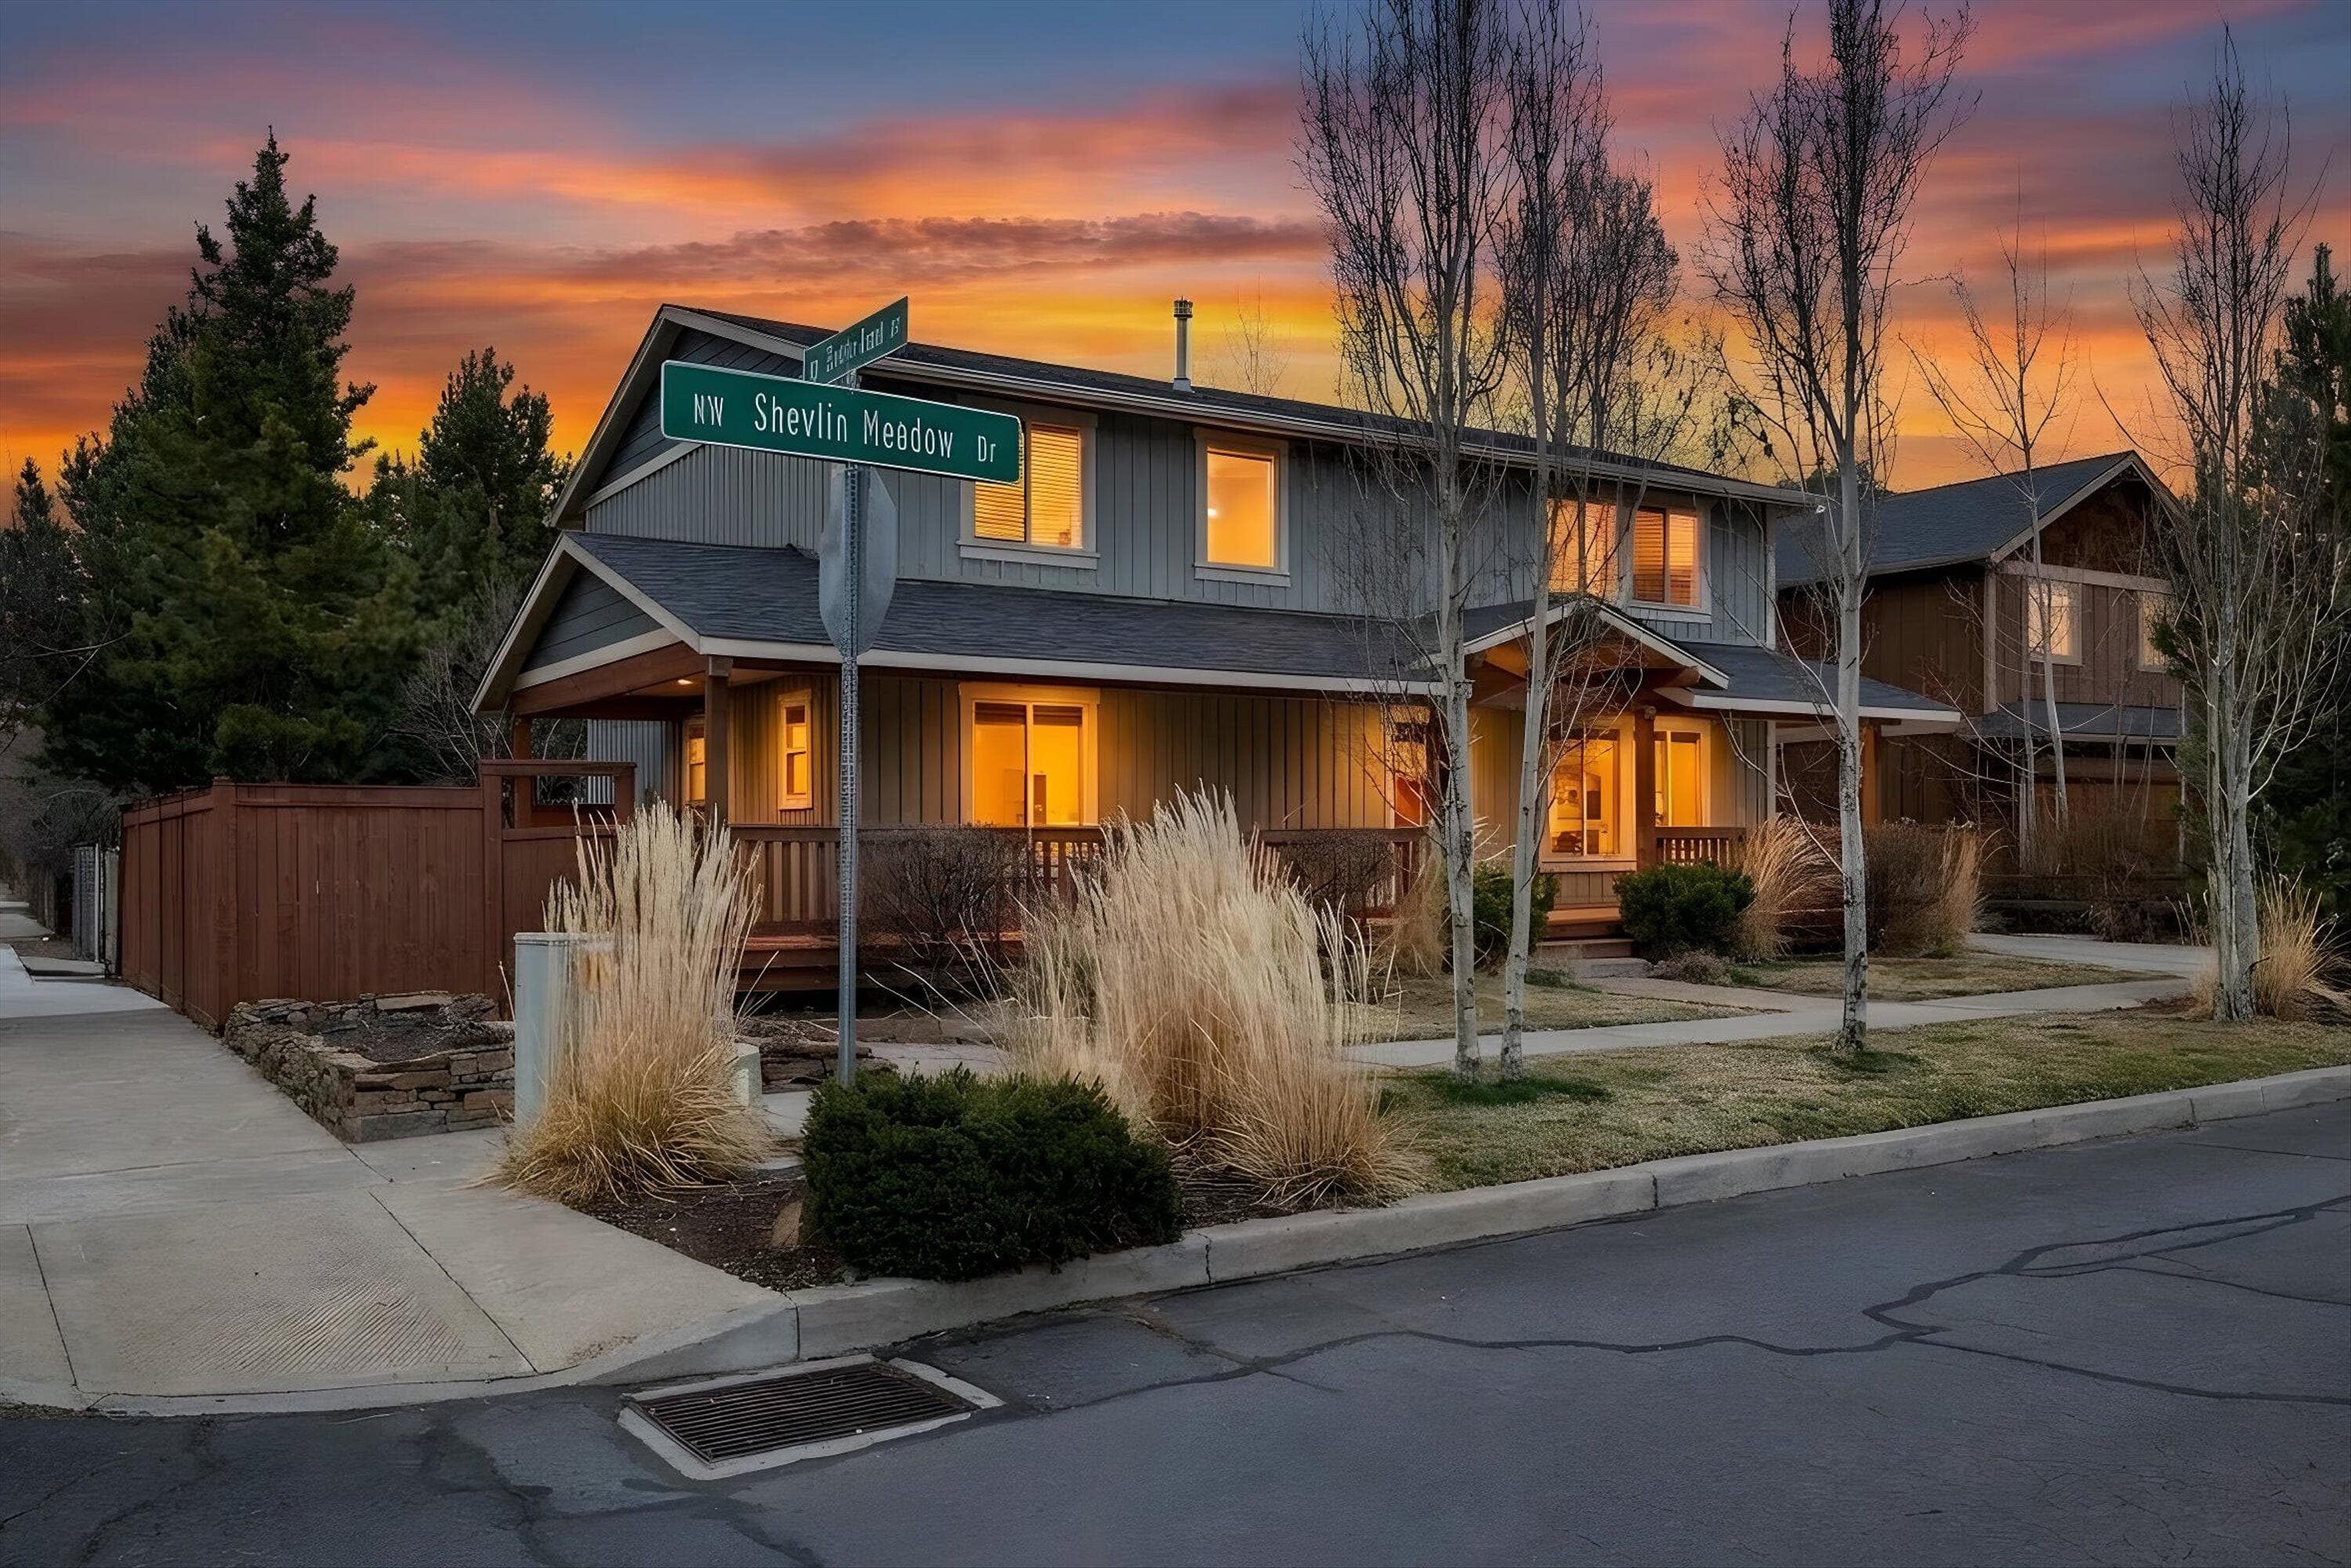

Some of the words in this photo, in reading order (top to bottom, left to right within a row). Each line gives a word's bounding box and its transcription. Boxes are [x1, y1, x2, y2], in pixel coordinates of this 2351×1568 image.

[694, 393, 724, 427] NW
[754, 393, 847, 443] Shevlin
[864, 409, 954, 458] Meadow
[977, 435, 996, 463] Dr
